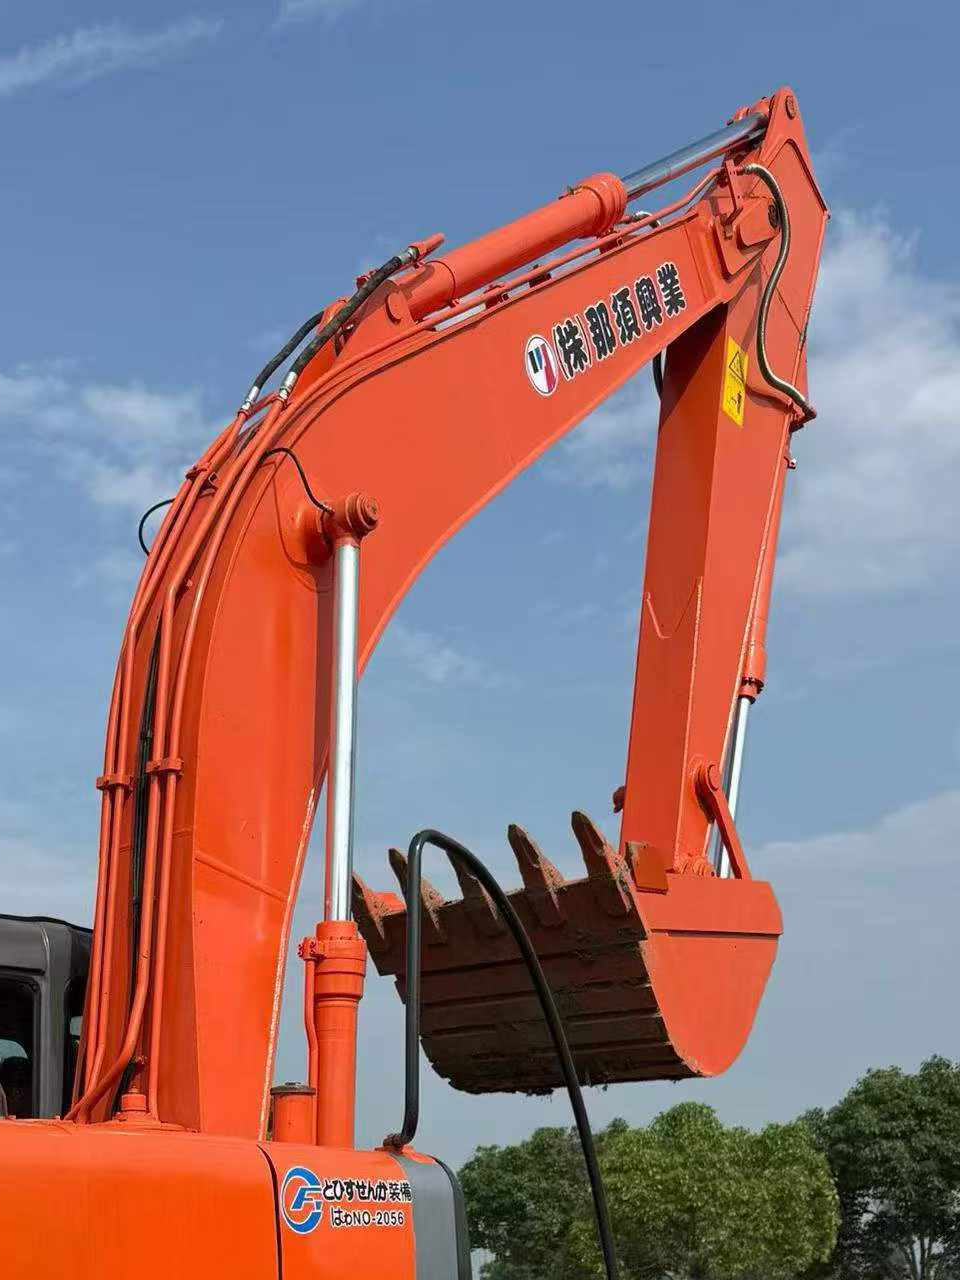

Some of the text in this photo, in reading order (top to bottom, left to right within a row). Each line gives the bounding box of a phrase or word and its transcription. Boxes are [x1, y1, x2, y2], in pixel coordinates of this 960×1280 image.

[552, 263, 686, 381] (株)那須興業
